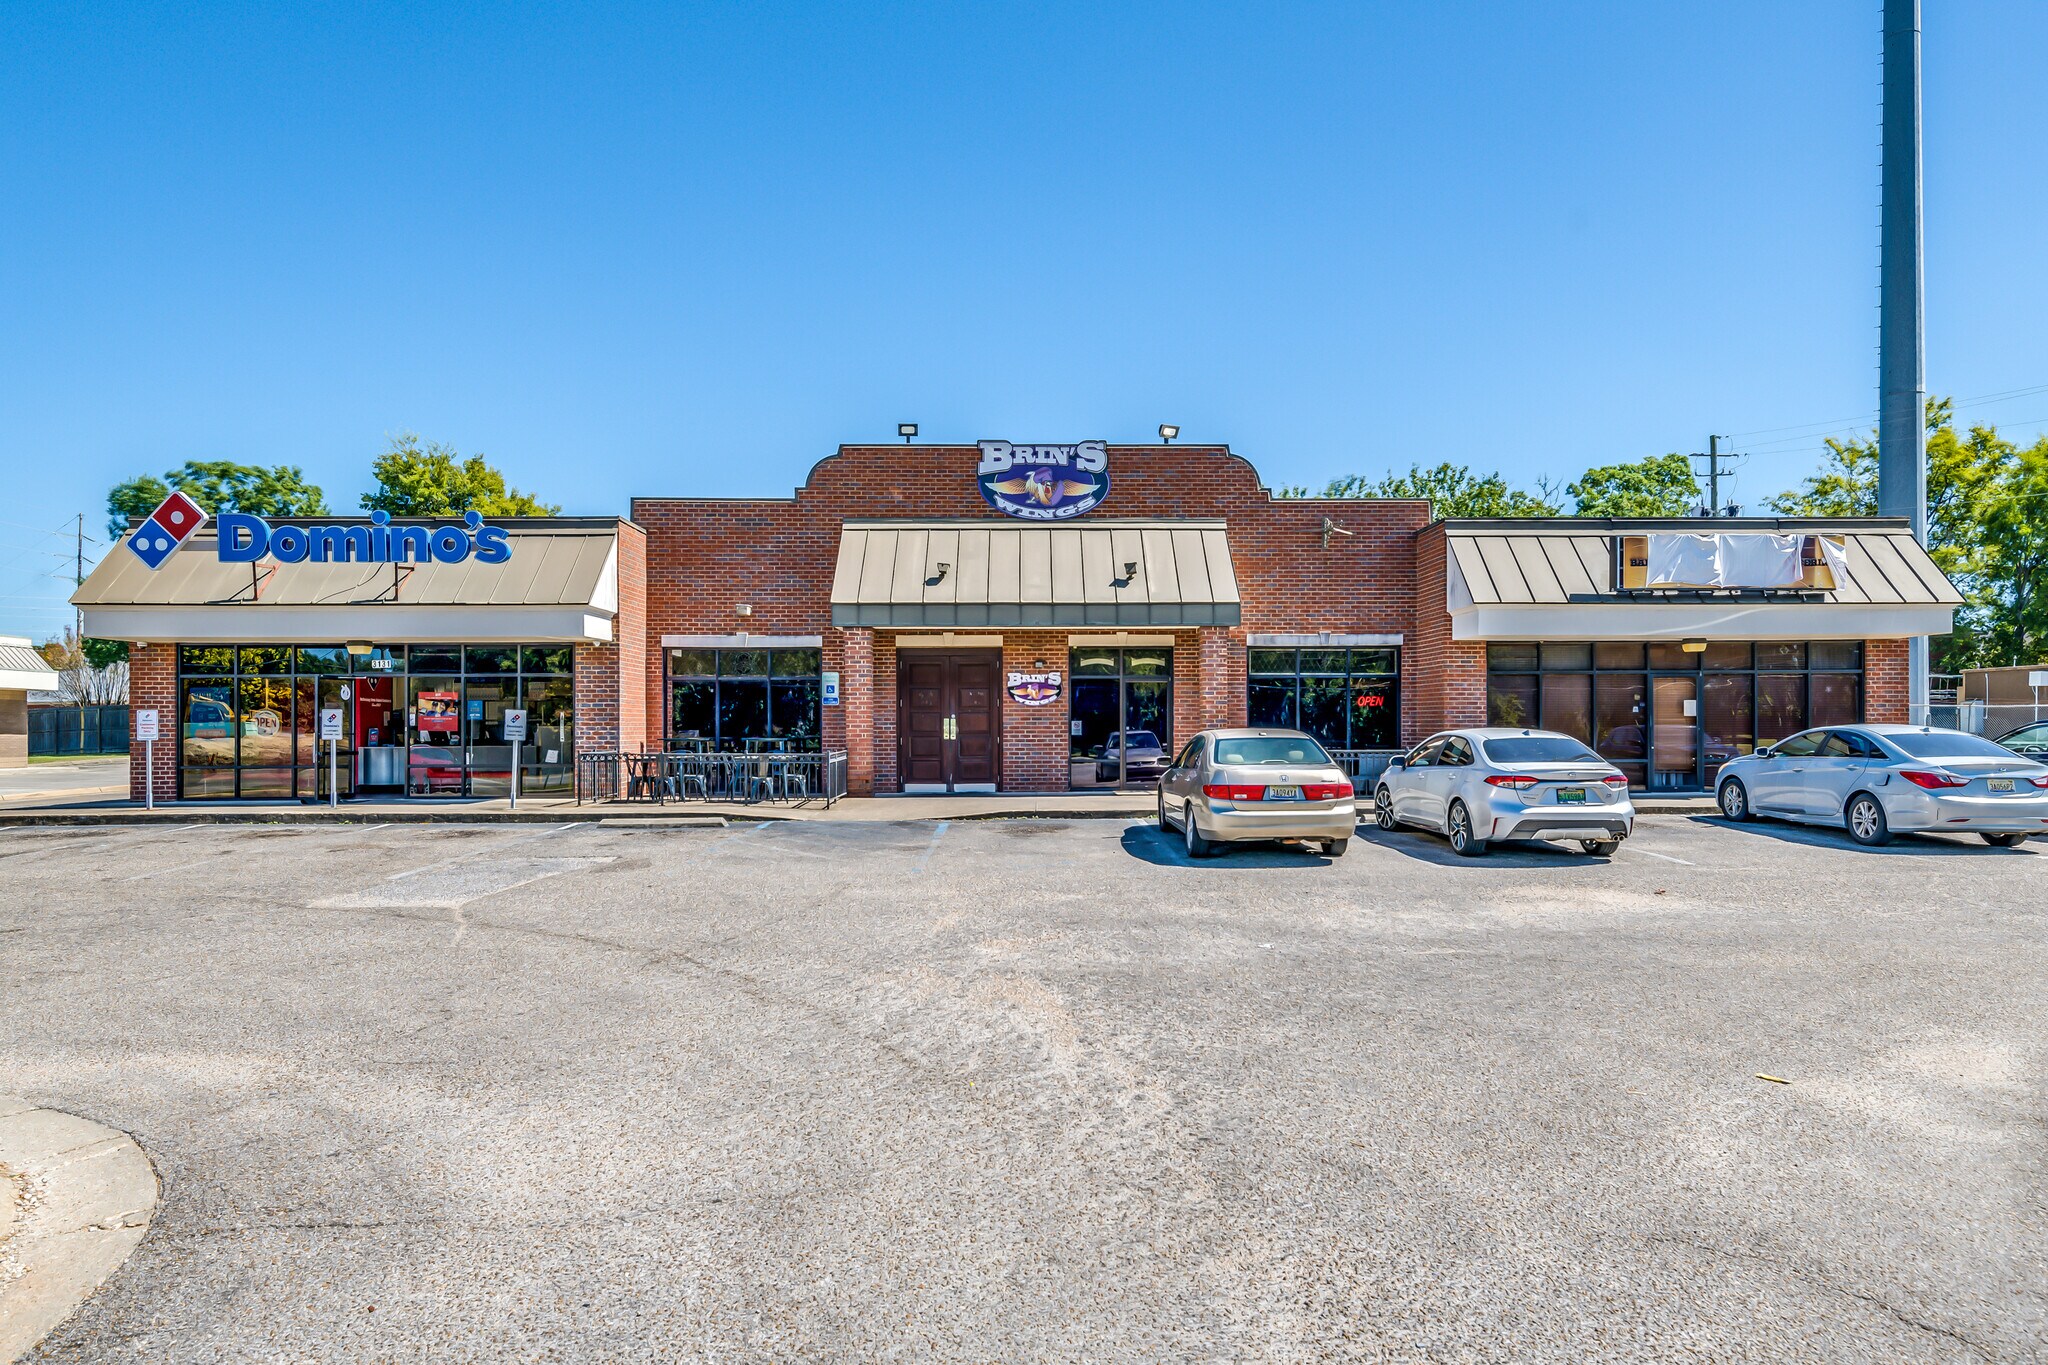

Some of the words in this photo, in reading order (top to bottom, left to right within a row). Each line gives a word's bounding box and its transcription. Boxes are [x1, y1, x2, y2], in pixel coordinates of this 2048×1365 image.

[977, 440, 1108, 475] BRIN'S
[993, 495, 1097, 518] WINGS
[216, 510, 511, 564] Domino's
[372, 660, 390, 668] 3131
[1007, 671, 1061, 687] BRIN'S
[1357, 695, 1385, 707] OPEN
